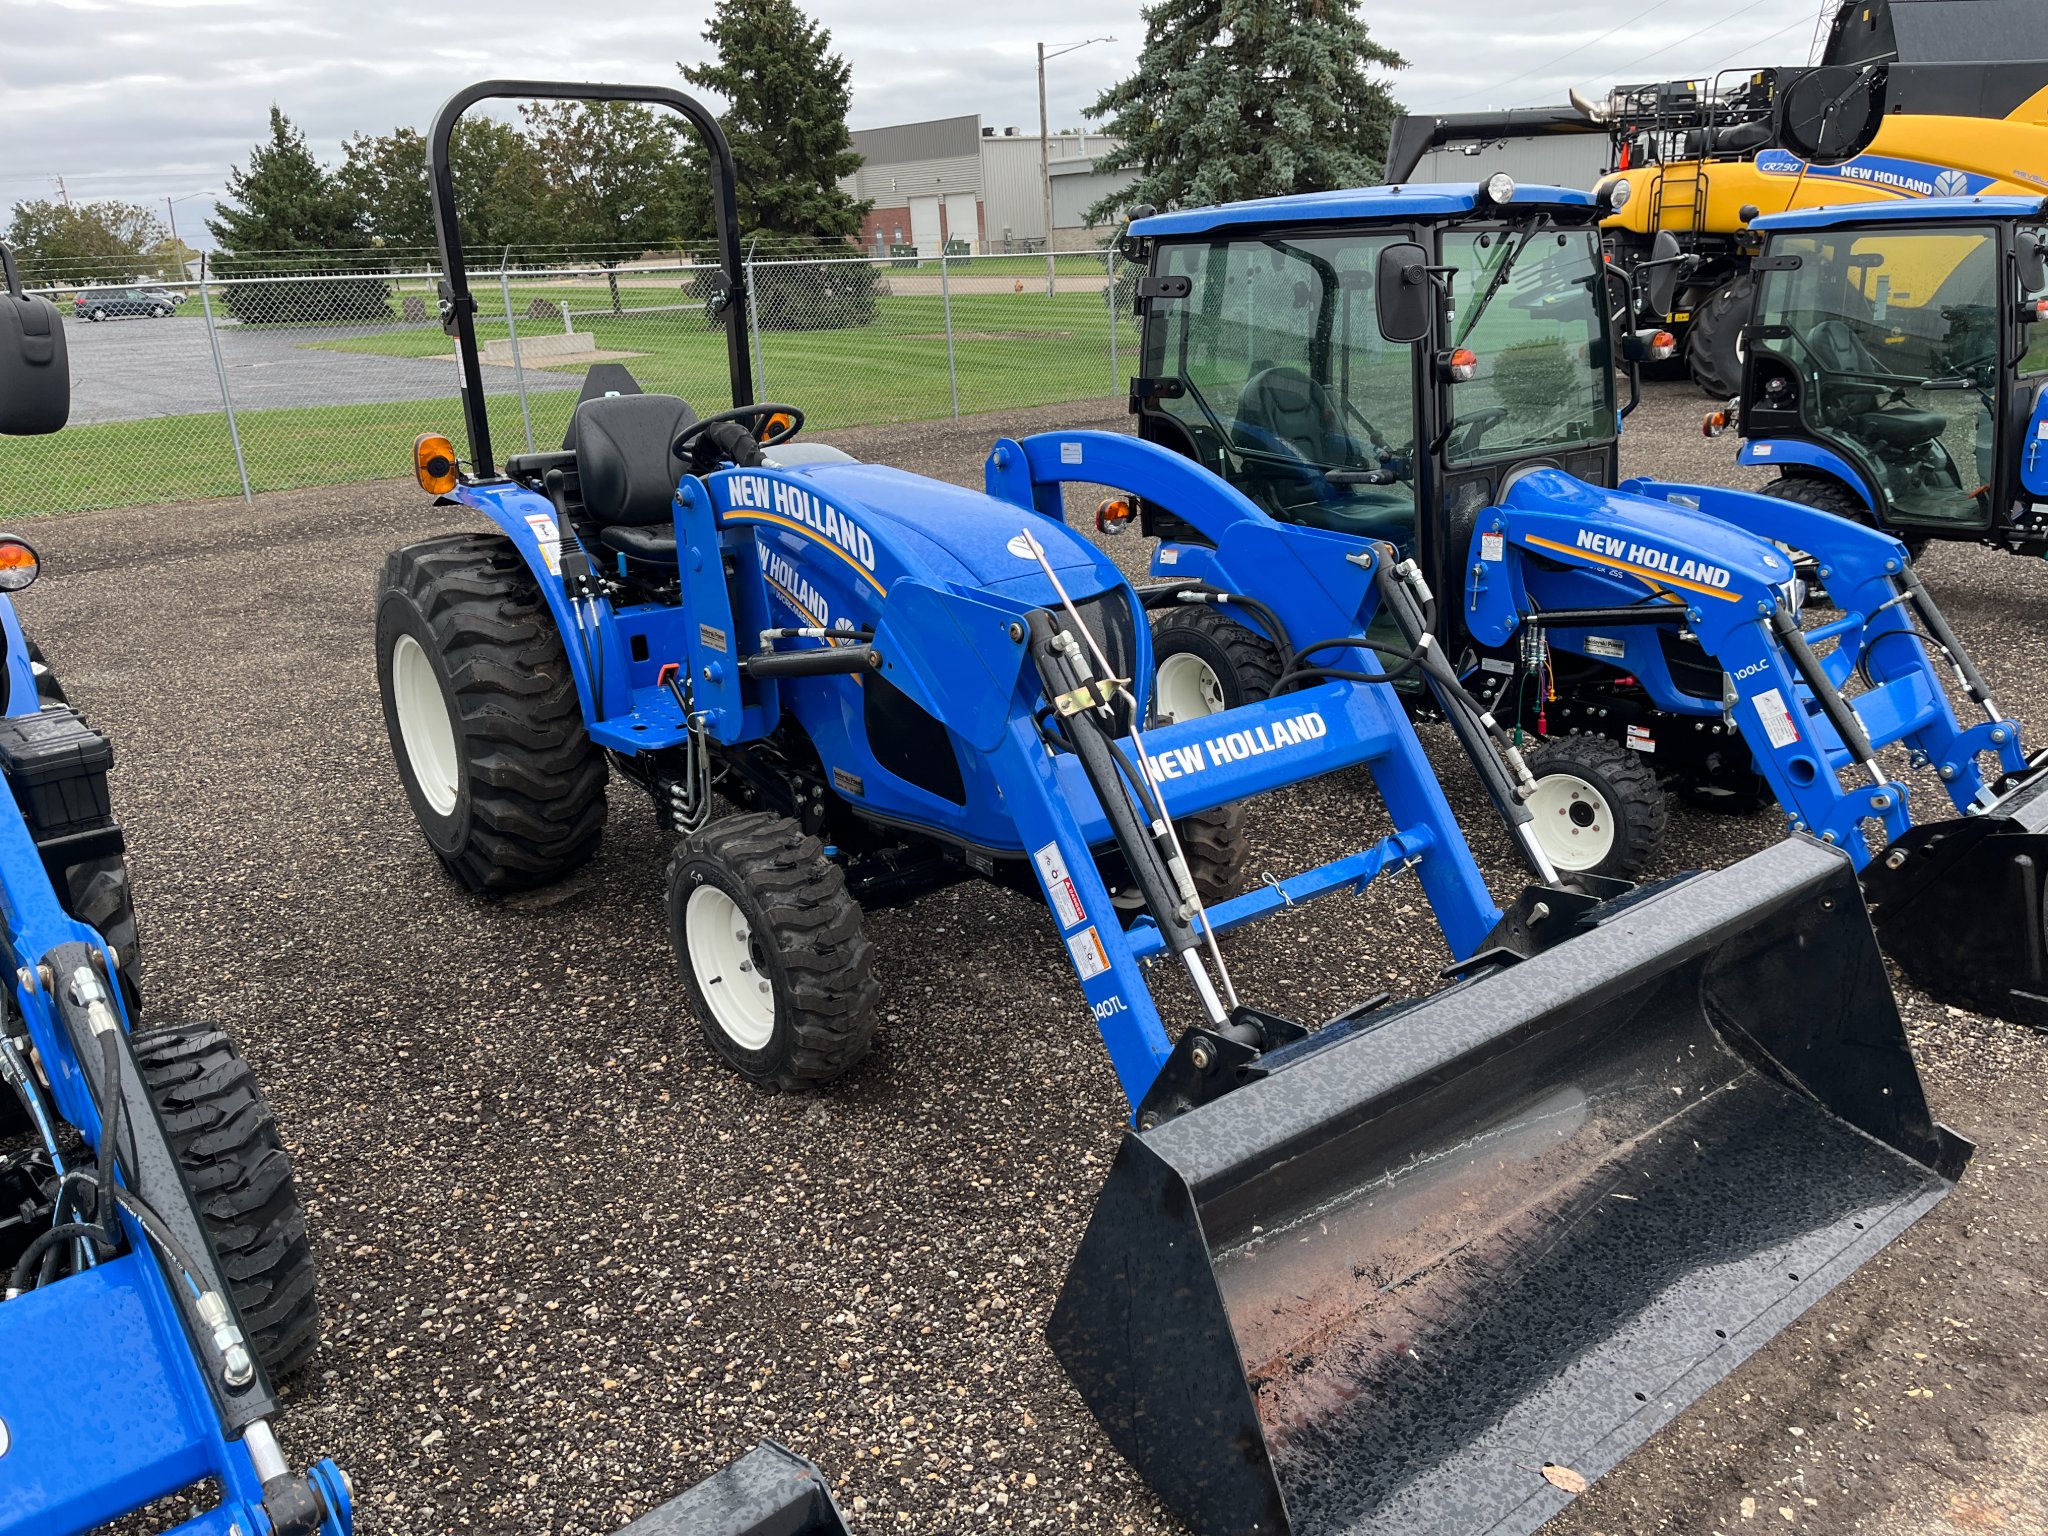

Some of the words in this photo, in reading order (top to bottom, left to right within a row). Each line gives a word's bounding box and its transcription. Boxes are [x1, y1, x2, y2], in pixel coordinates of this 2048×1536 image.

[1762, 162, 1798, 172] CR7.90
[1840, 165, 1872, 180] NEW
[1874, 170, 1933, 196] HOLLAND
[727, 475, 770, 509] NEW
[772, 479, 876, 572] HOLLAND
[1576, 528, 1627, 558] NEW
[1627, 543, 1731, 589] HOLLAND
[770, 552, 829, 627] HOLLAND
[1734, 658, 1770, 681] 100LC
[1137, 743, 1206, 786] NEW
[1205, 712, 1327, 766] HOLLAND
[1068, 885, 1084, 919] DANGER
